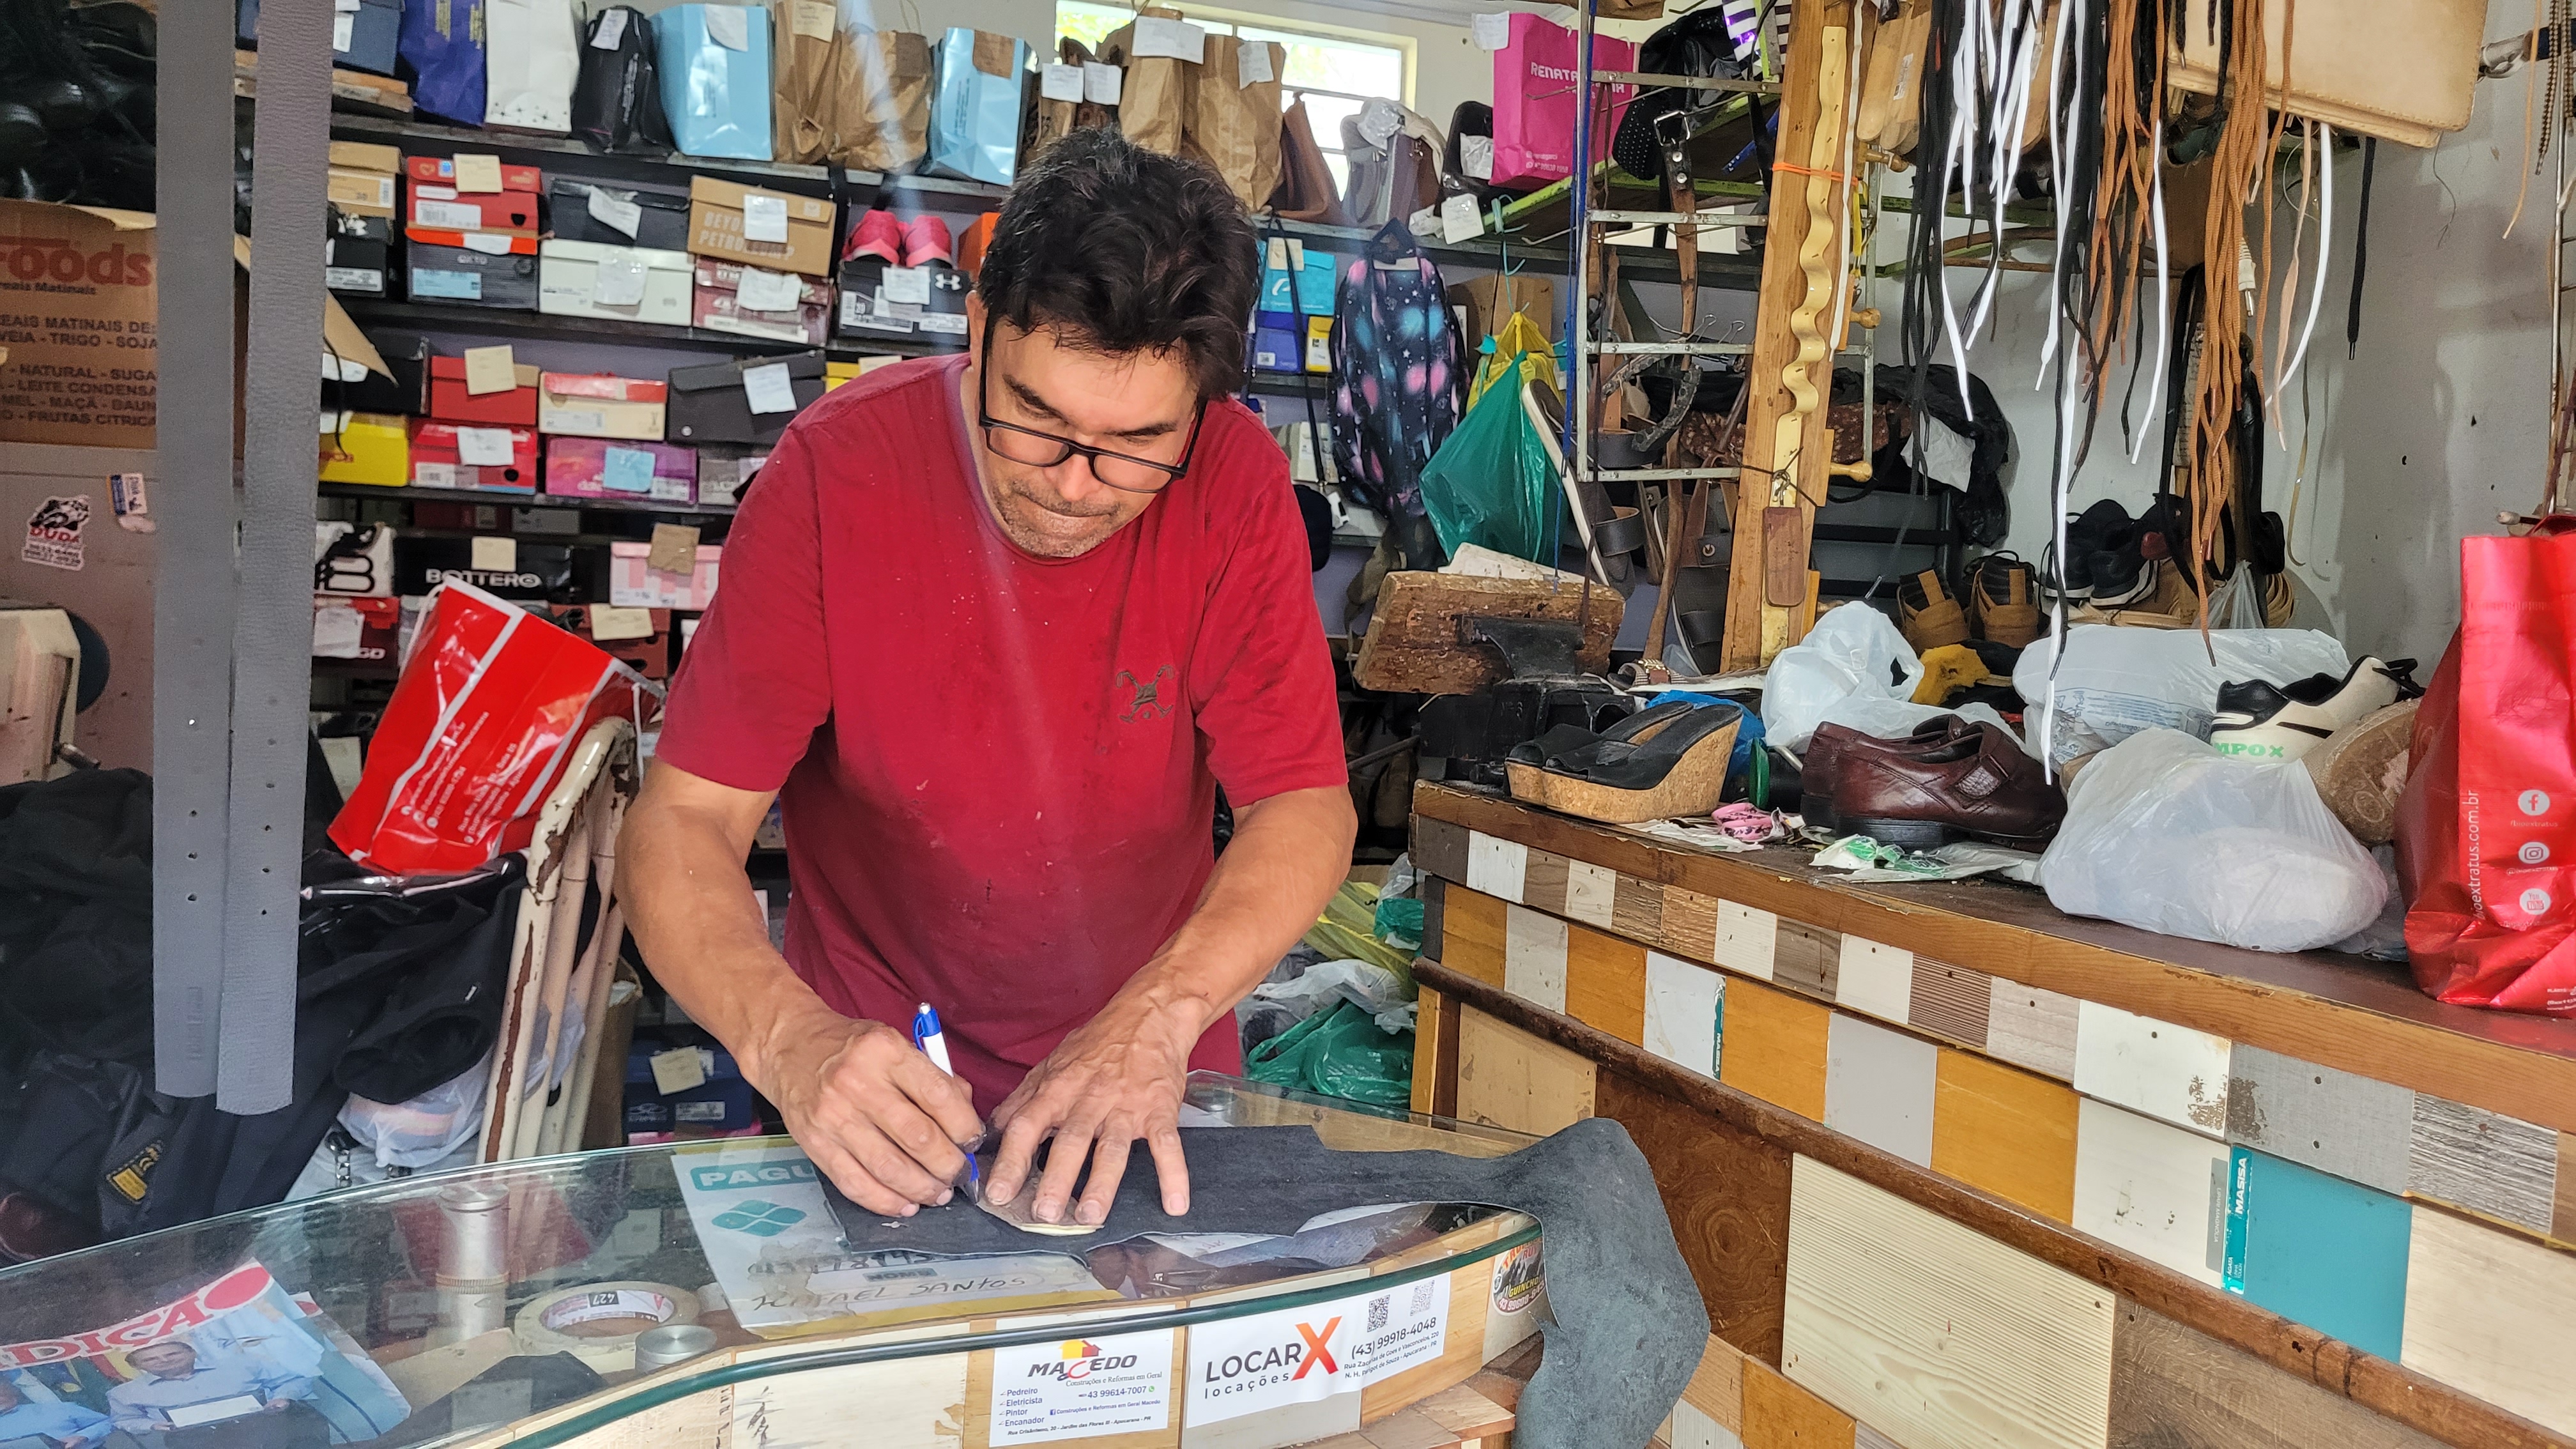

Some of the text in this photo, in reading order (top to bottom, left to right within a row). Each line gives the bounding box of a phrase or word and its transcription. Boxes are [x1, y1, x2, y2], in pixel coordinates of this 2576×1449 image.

[1530, 62, 1578, 82] RENATA
[704, 211, 743, 232] BEYO
[45, 317, 123, 332] MATINAIS
[49, 332, 101, 348] TRIGO
[116, 336, 157, 349] SOJA
[20, 364, 96, 379] NATURAL
[18, 380, 64, 392] LEITE
[27, 411, 91, 424] FRUTAS
[2462, 790, 2485, 920] bioextratus.com.br
[699, 1164, 816, 1186] PAGU
[2235, 1157, 2247, 1215] MASISA
[909, 1276, 1026, 1296] SANTOS
[1508, 1276, 1539, 1298] GUINCHO
[592, 1292, 615, 1305] 427
[1499, 1298, 1508, 1310] 43
[2, 1294, 213, 1366] DICA
[1351, 1317, 1436, 1360] (43) 99918-4048
[1386, 1357, 1399, 1366] Souza
[1403, 1346, 1427, 1358] Apucarana
[1027, 1354, 1137, 1381] MACEDO
[1066, 1378, 1101, 1387] Construções
[1108, 1375, 1135, 1383] Reformas
[1205, 1372, 1289, 1399] locações
[1006, 1387, 1038, 1397] Pedreiro
[1087, 1386, 1146, 1399] 43 99614-7007
[1006, 1397, 1043, 1407] Eletricista
[1006, 1407, 1028, 1416] Pintor
[1056, 1406, 1087, 1415] Construções
[1005, 1416, 1045, 1427] Encanador
[1114, 1418, 1140, 1426] Apucarana
